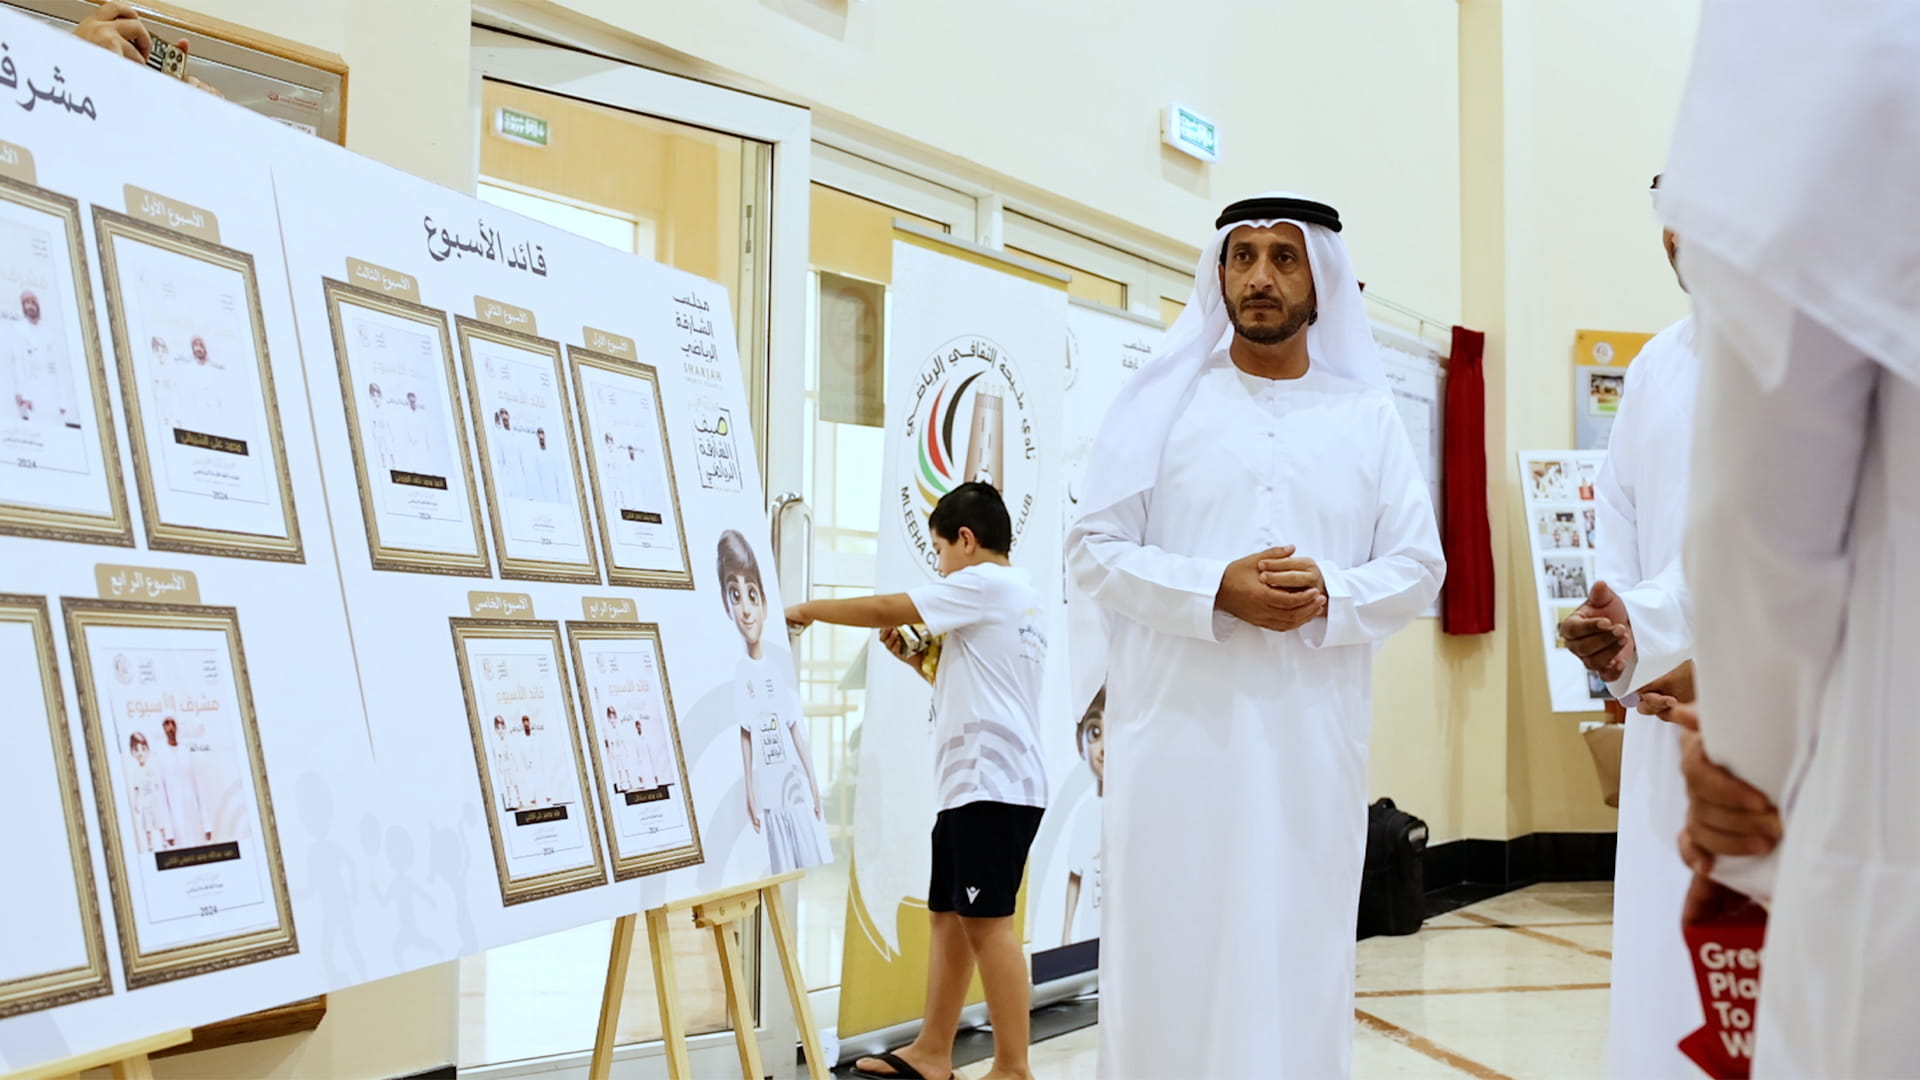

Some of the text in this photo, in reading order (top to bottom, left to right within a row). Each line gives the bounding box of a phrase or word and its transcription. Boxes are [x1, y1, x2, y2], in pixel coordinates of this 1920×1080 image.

[423, 215, 547, 277] قائد الأسبوع
[672, 291, 710, 312] مجلس
[675, 311, 714, 339] الشارقة
[680, 339, 718, 363] الرياضي
[948, 340, 998, 369] الثقافي
[907, 354, 946, 437] الرياضي
[999, 356, 1025, 411] مليحة
[699, 438, 734, 460] الشارقة
[1022, 418, 1035, 461] نادي
[901, 486, 927, 556] MLEEHA
[1015, 493, 1034, 535] CLUB
[1699, 941, 1763, 970] Gre
[1708, 972, 1758, 999] Pla
[1712, 1001, 1751, 1029] To
